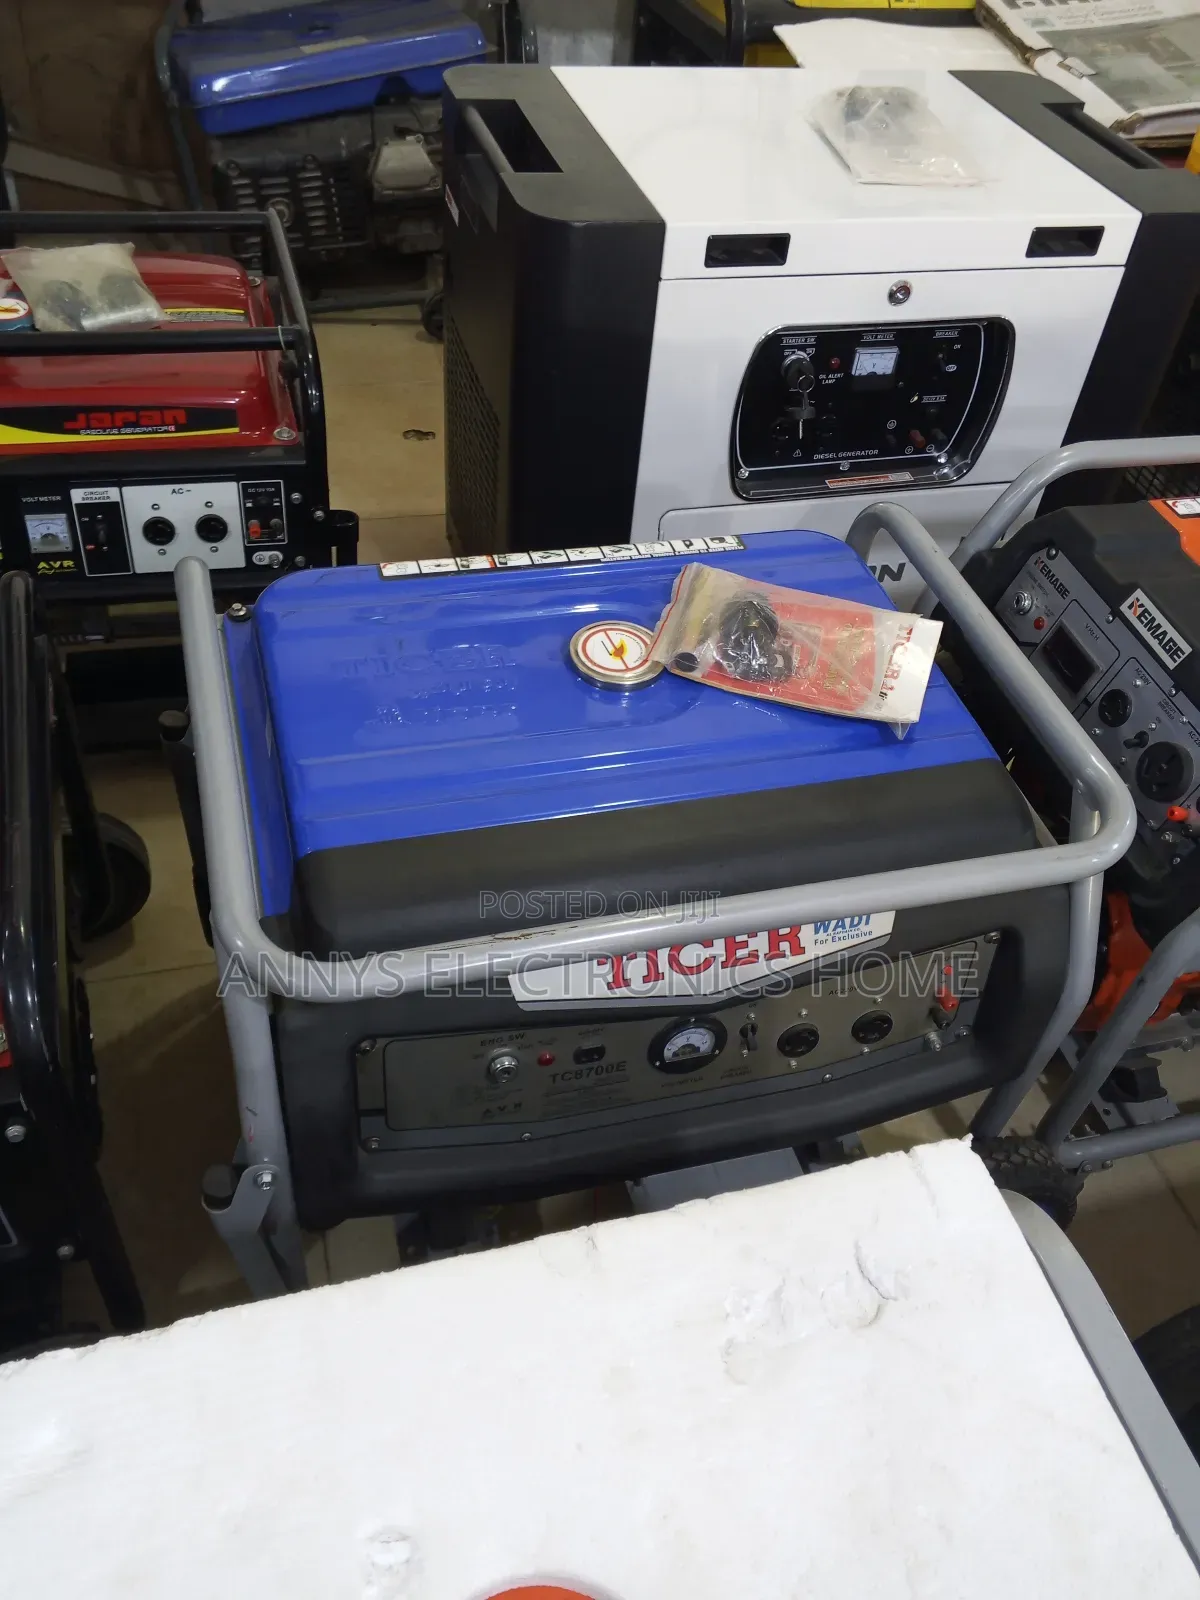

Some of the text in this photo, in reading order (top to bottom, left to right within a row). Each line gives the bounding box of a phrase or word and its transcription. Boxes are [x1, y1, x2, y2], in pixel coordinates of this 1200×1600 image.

[813, 449, 879, 460] DIESEL GENERATOR
[37, 560, 76, 569] AVR
[1033, 556, 1071, 601] KEMAGE
[1127, 597, 1186, 664] KEMAGE
[1157, 701, 1175, 721] BREAKER
[1162, 698, 1177, 714] CIRCUIT
[1187, 730, 1196, 740] AC
[814, 930, 873, 946] For Exclusive
[507, 1032, 526, 1042] SW
[549, 1060, 628, 1084] TC8700E
